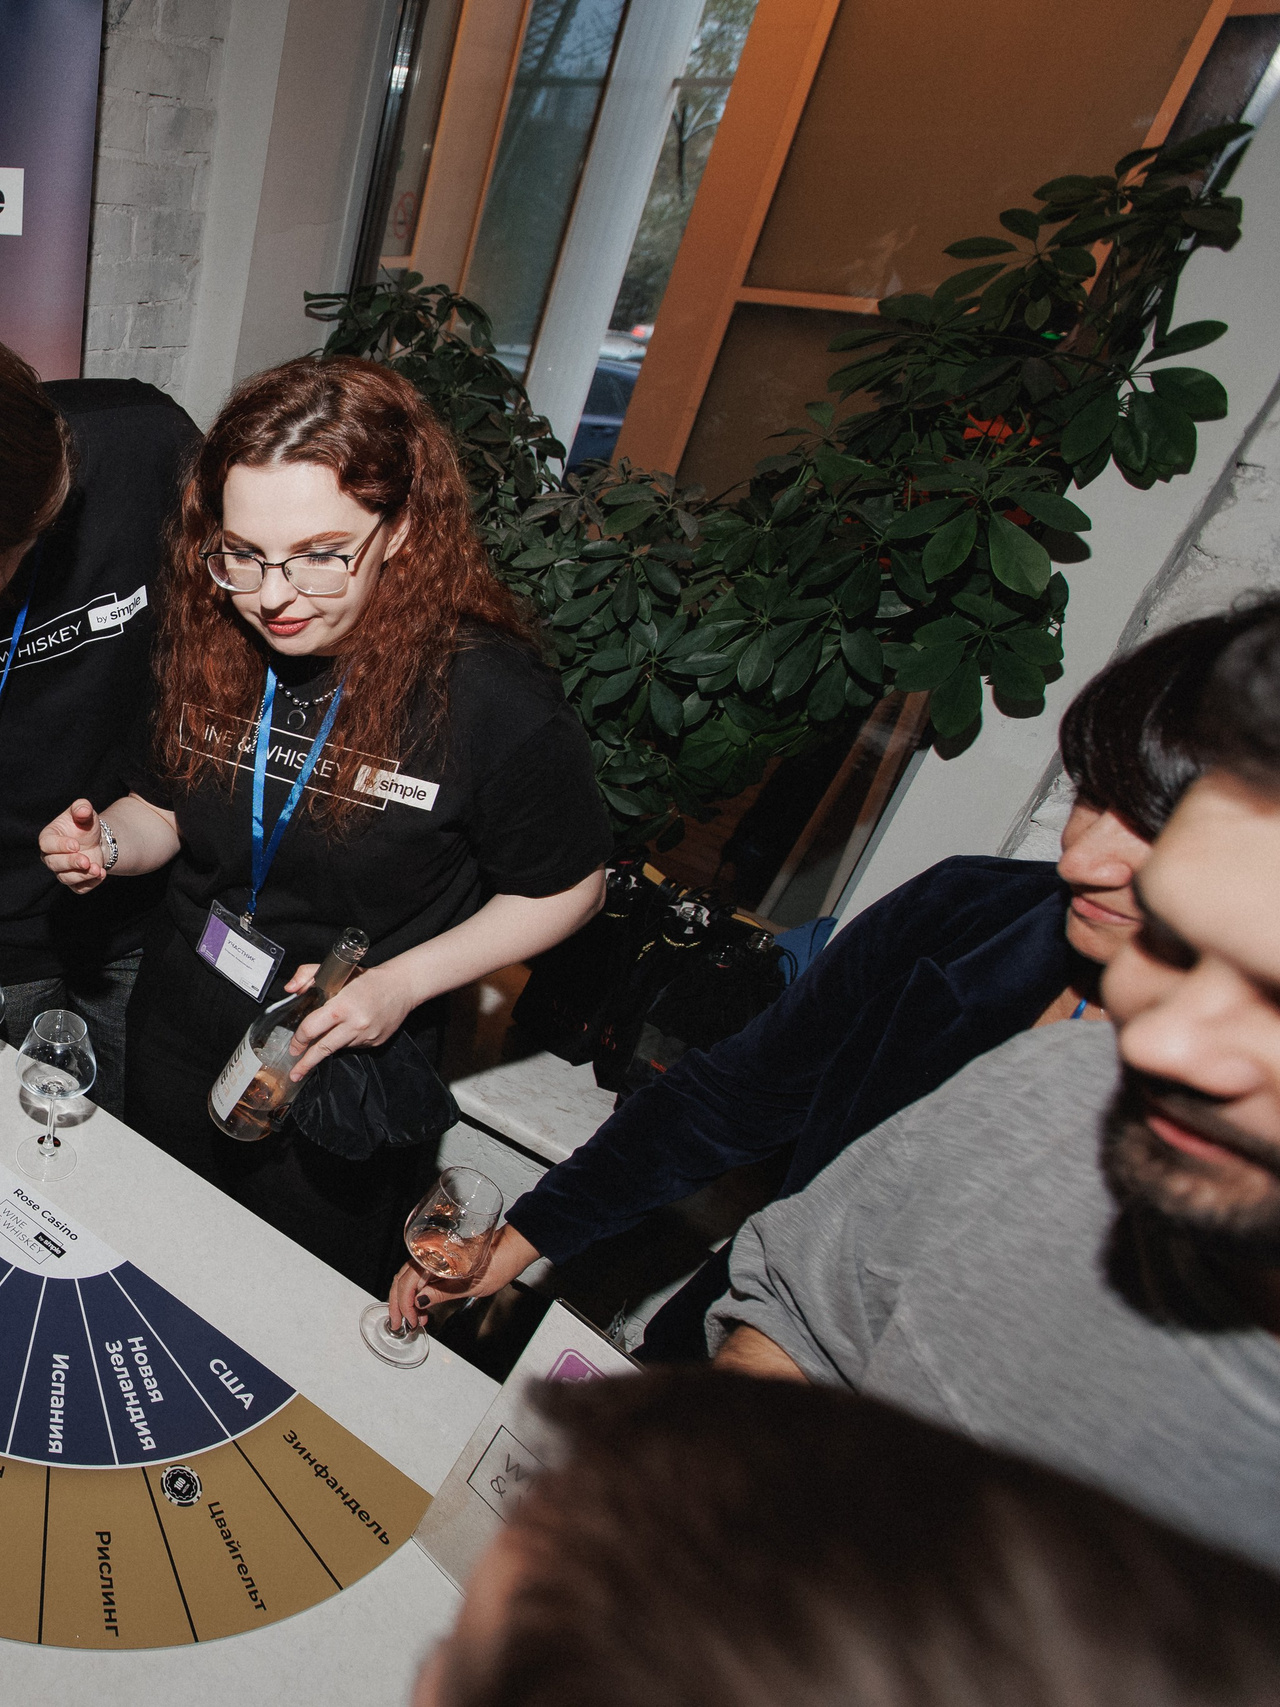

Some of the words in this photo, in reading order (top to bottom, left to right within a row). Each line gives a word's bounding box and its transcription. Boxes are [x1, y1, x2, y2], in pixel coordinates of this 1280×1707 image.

[96, 616, 108, 624] by
[110, 596, 141, 620] simple
[204, 724, 236, 747] INE
[380, 779, 427, 801] simple
[2, 1207, 28, 1229] WINE
[2, 1220, 45, 1254] WHISKEY
[13, 1188, 40, 1211] Rose
[41, 1210, 78, 1241] Casino
[105, 1339, 157, 1450] Зеландия
[127, 1336, 164, 1403] Новая
[209, 1358, 255, 1411] США
[48, 1353, 70, 1454] Испания
[174, 1477, 186, 1490] 100
[282, 1429, 391, 1546] Зинфандель
[95, 1531, 119, 1638] Рислинг
[207, 1501, 267, 1612] Цвайгельт
